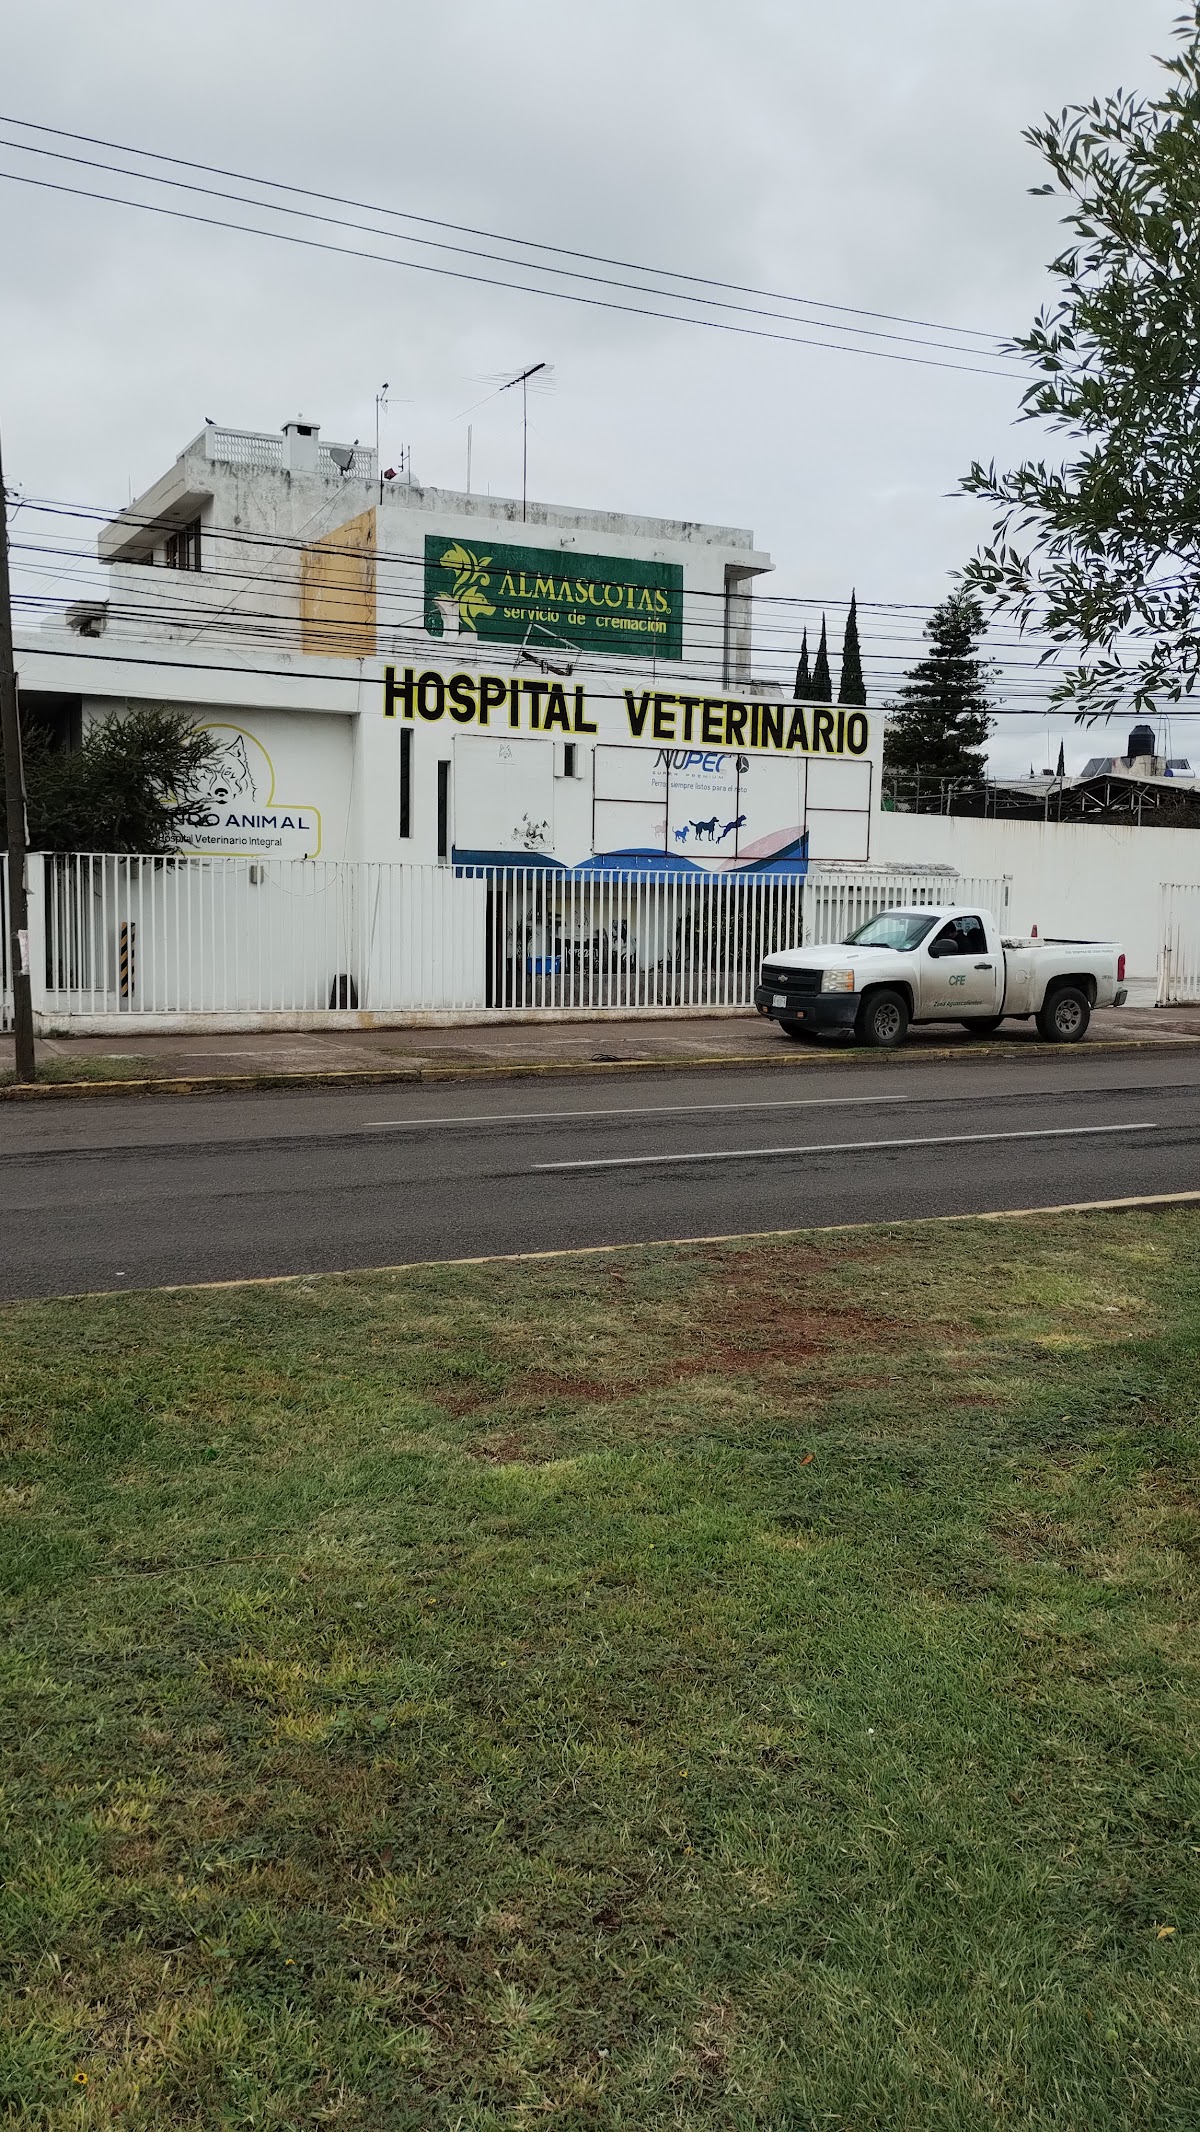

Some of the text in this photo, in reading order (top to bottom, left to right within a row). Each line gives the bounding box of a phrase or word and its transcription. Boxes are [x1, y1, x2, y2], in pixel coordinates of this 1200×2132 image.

[498, 570, 668, 613] ALMASCOTAS
[503, 606, 667, 634] servicio de cremación
[384, 665, 868, 755] HOSPITAL VETERINARIO
[670, 781, 694, 790] siempre
[225, 814, 310, 830] ANIMAL
[195, 834, 247, 845] Veterinario
[249, 836, 283, 848] Integral
[948, 974, 966, 986] CFE
